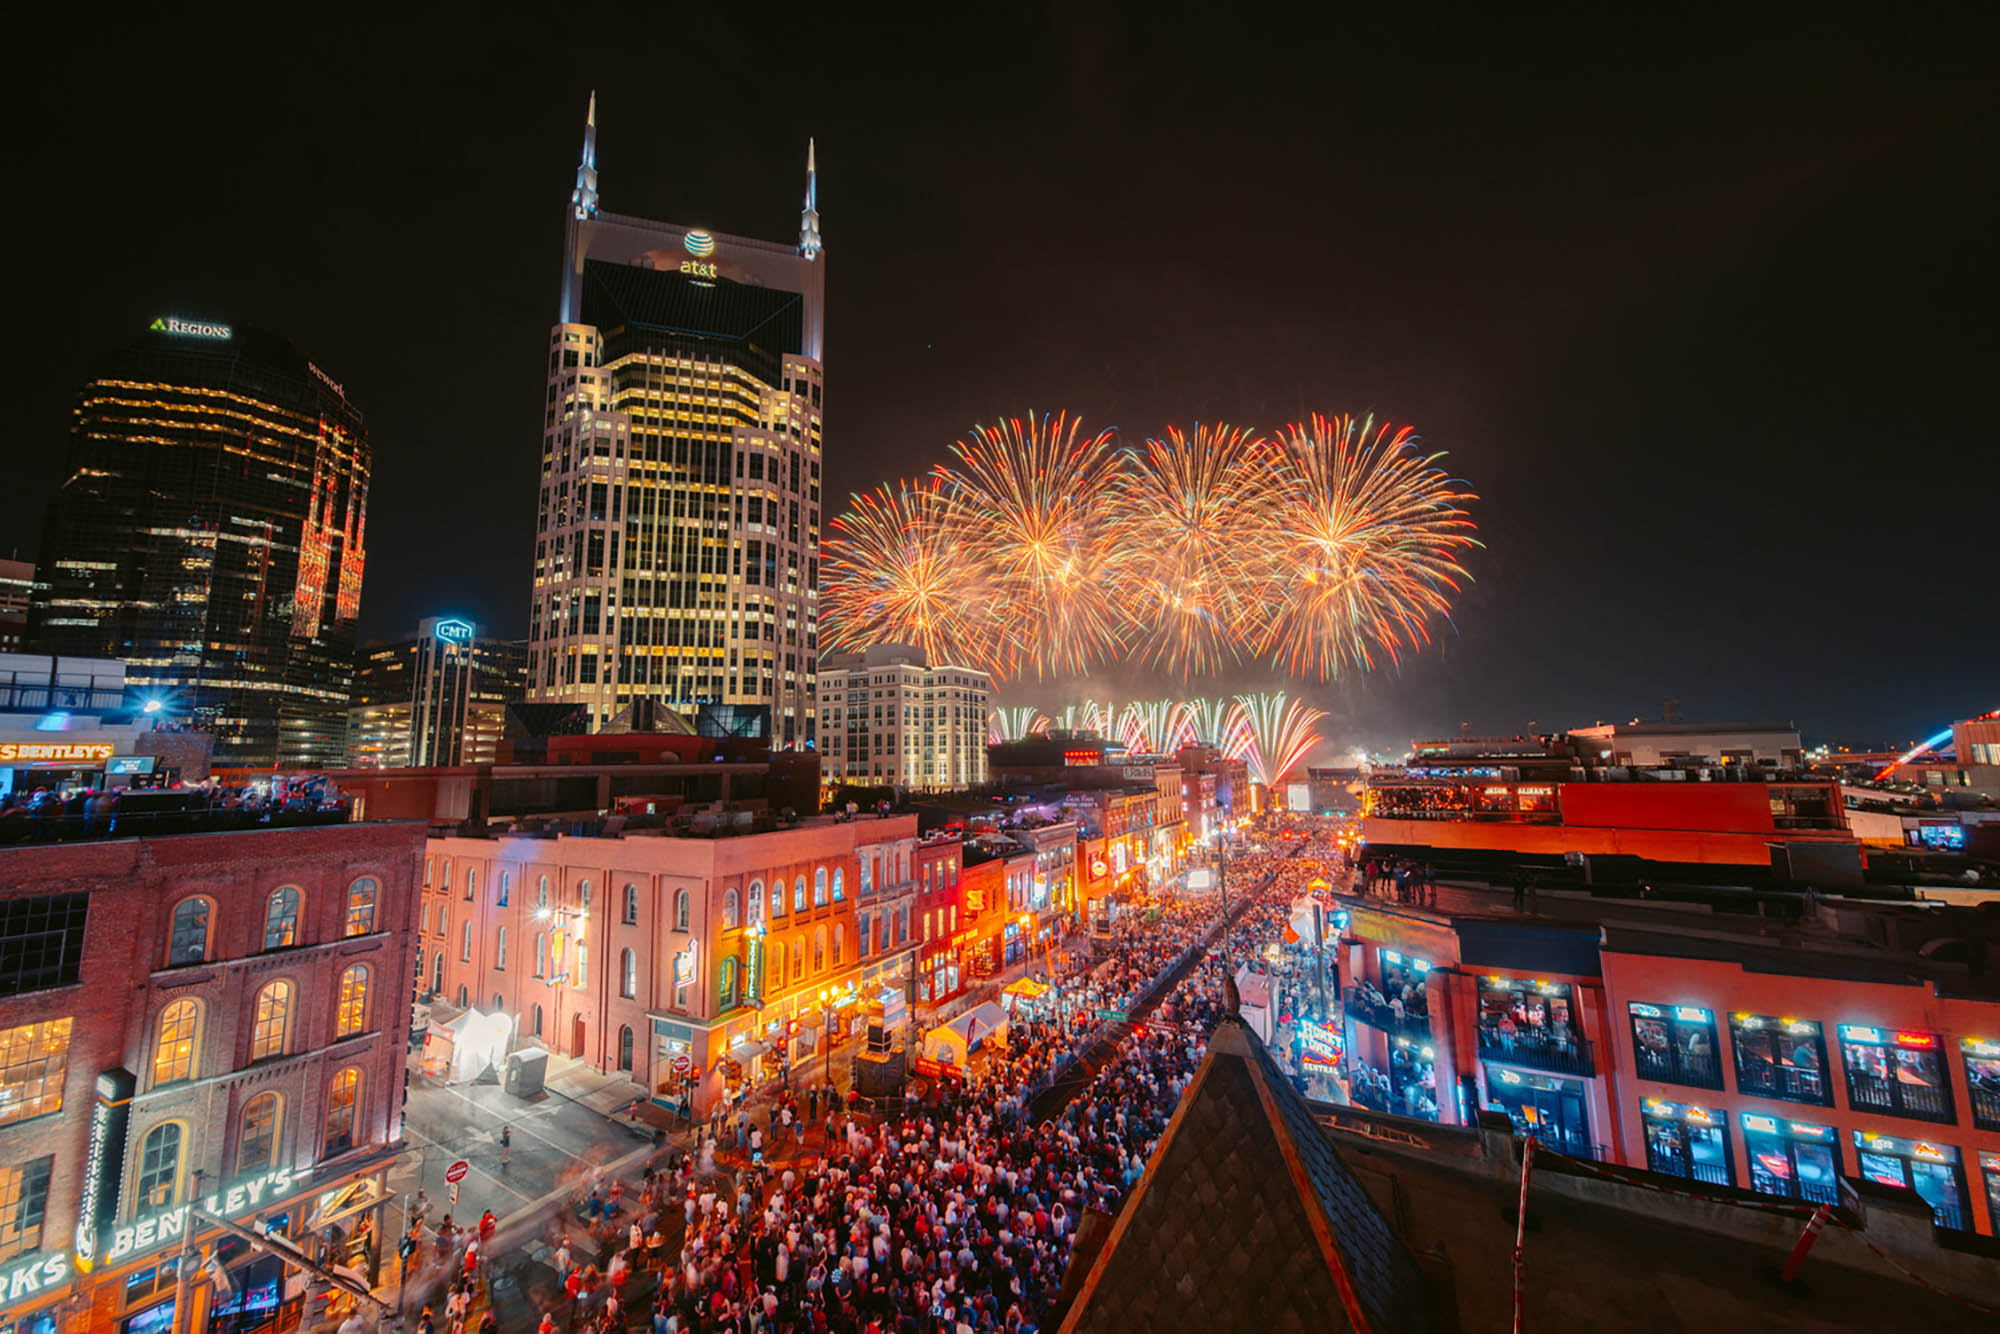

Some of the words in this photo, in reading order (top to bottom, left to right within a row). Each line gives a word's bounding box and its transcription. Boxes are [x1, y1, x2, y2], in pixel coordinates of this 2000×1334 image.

[680, 260, 718, 279] at&t
[168, 318, 230, 338] REGIONS
[440, 625, 468, 638] CMT
[18, 744, 111, 760] BENTLEY'S
[1301, 1019, 1344, 1049] HONKY
[1297, 1031, 1333, 1058] TONK
[109, 1168, 291, 1258] BENLEY'S
